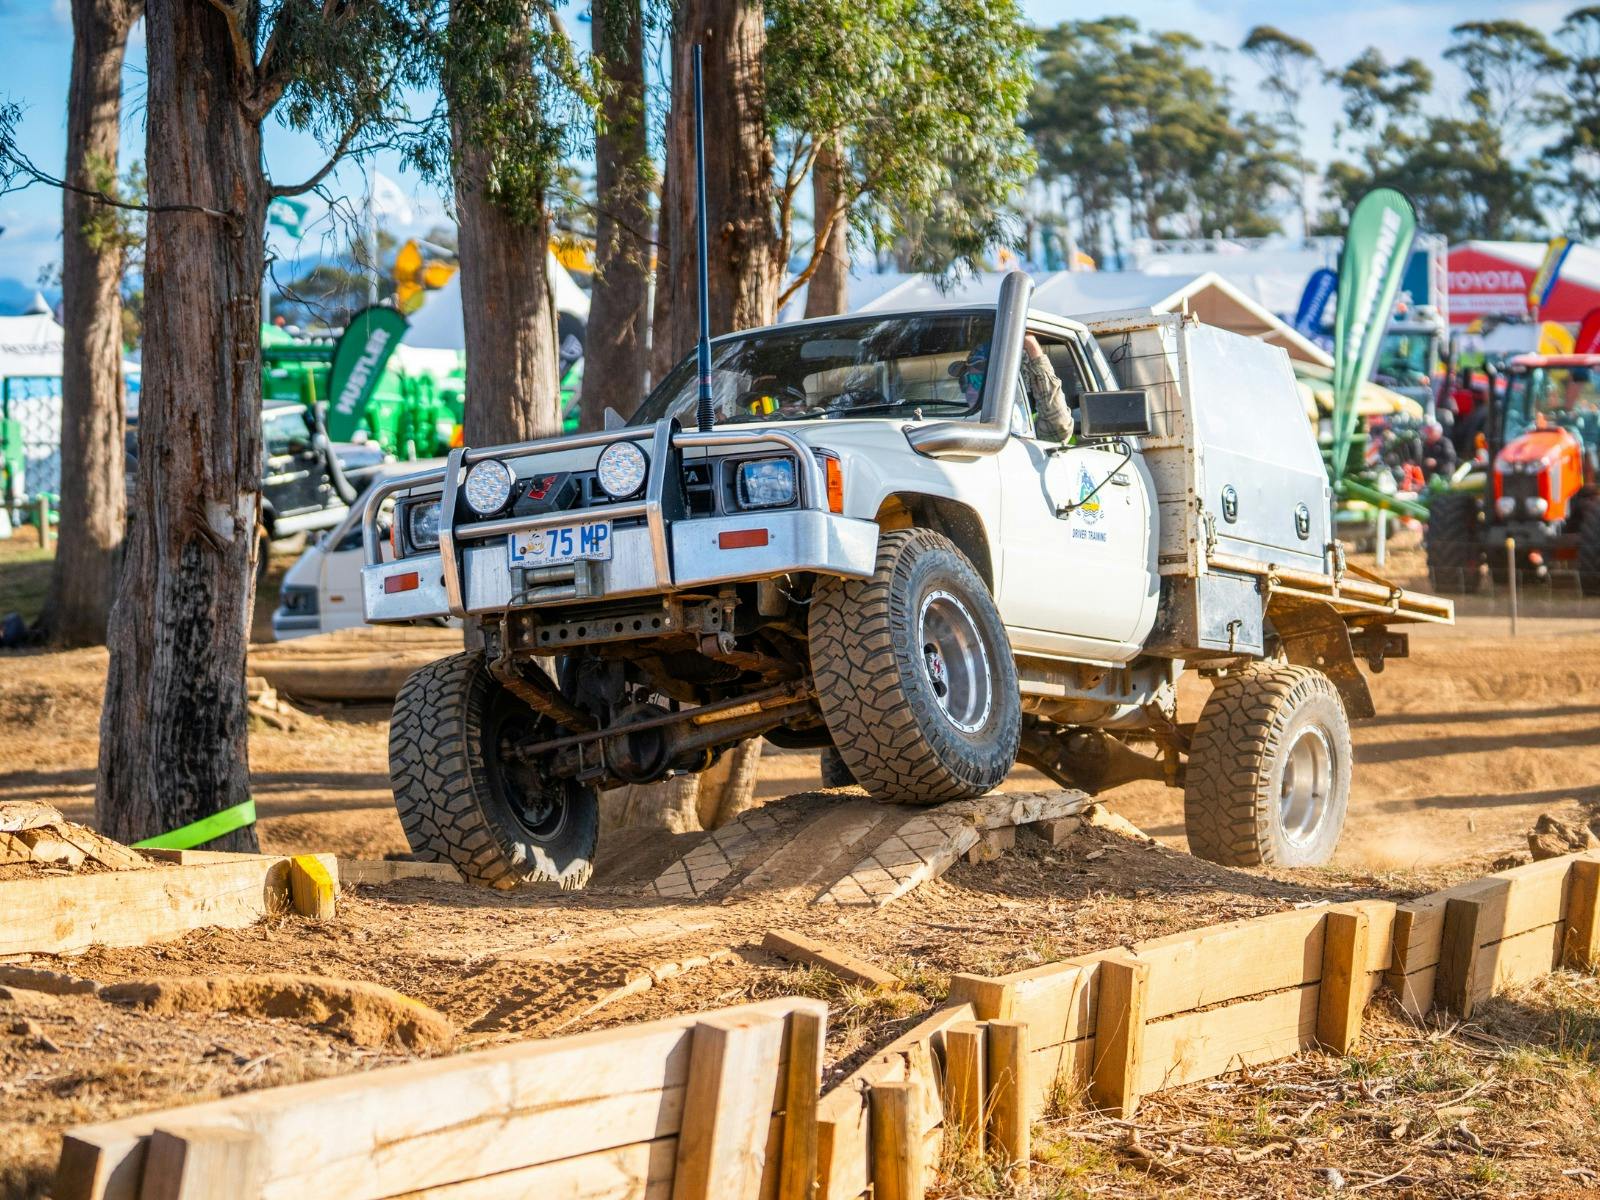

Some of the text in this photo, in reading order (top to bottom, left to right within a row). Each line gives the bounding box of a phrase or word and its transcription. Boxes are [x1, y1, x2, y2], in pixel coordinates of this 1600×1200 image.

[1447, 270, 1526, 290] TOYOTA
[335, 328, 391, 415] HUSTLER
[511, 524, 608, 561] L 75 MP
[1072, 528, 1107, 542] DRIVER TRAINING
